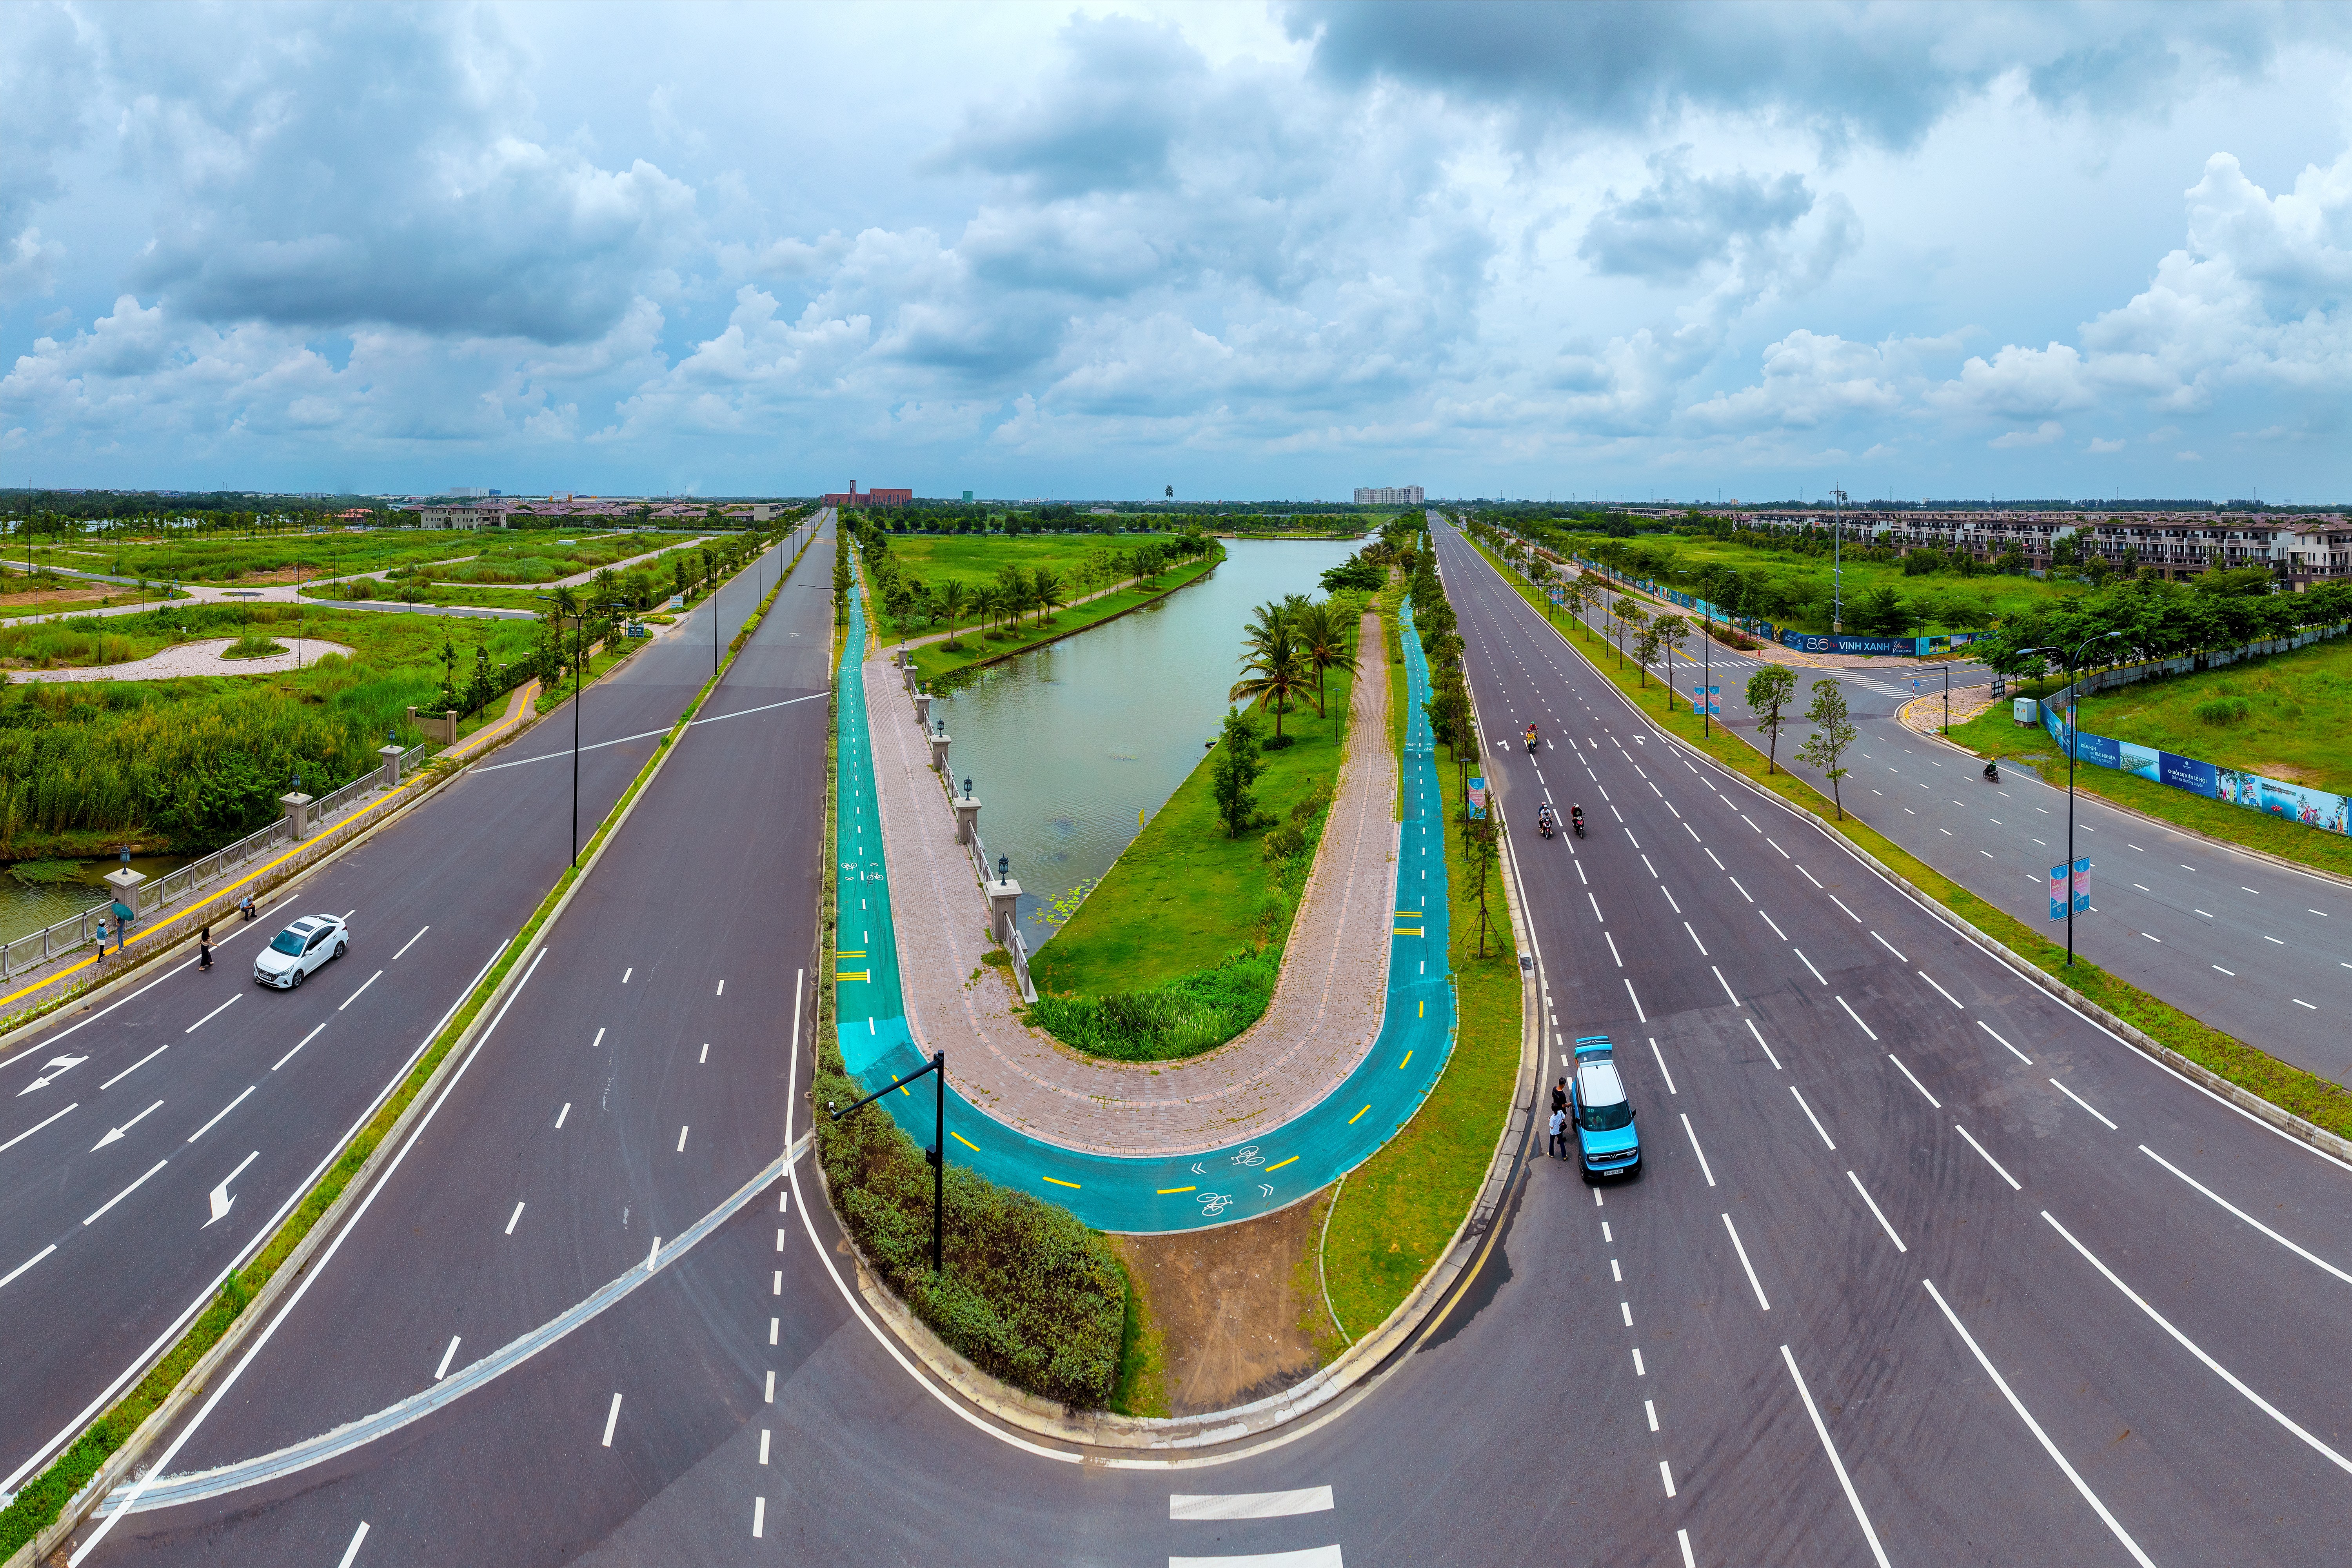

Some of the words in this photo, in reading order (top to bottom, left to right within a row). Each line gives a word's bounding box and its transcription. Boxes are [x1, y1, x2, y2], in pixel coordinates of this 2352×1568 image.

[1807, 638, 1829, 650] 8.6
[1839, 641, 1861, 652] VỊNH
[1864, 642, 1890, 650] XANH
